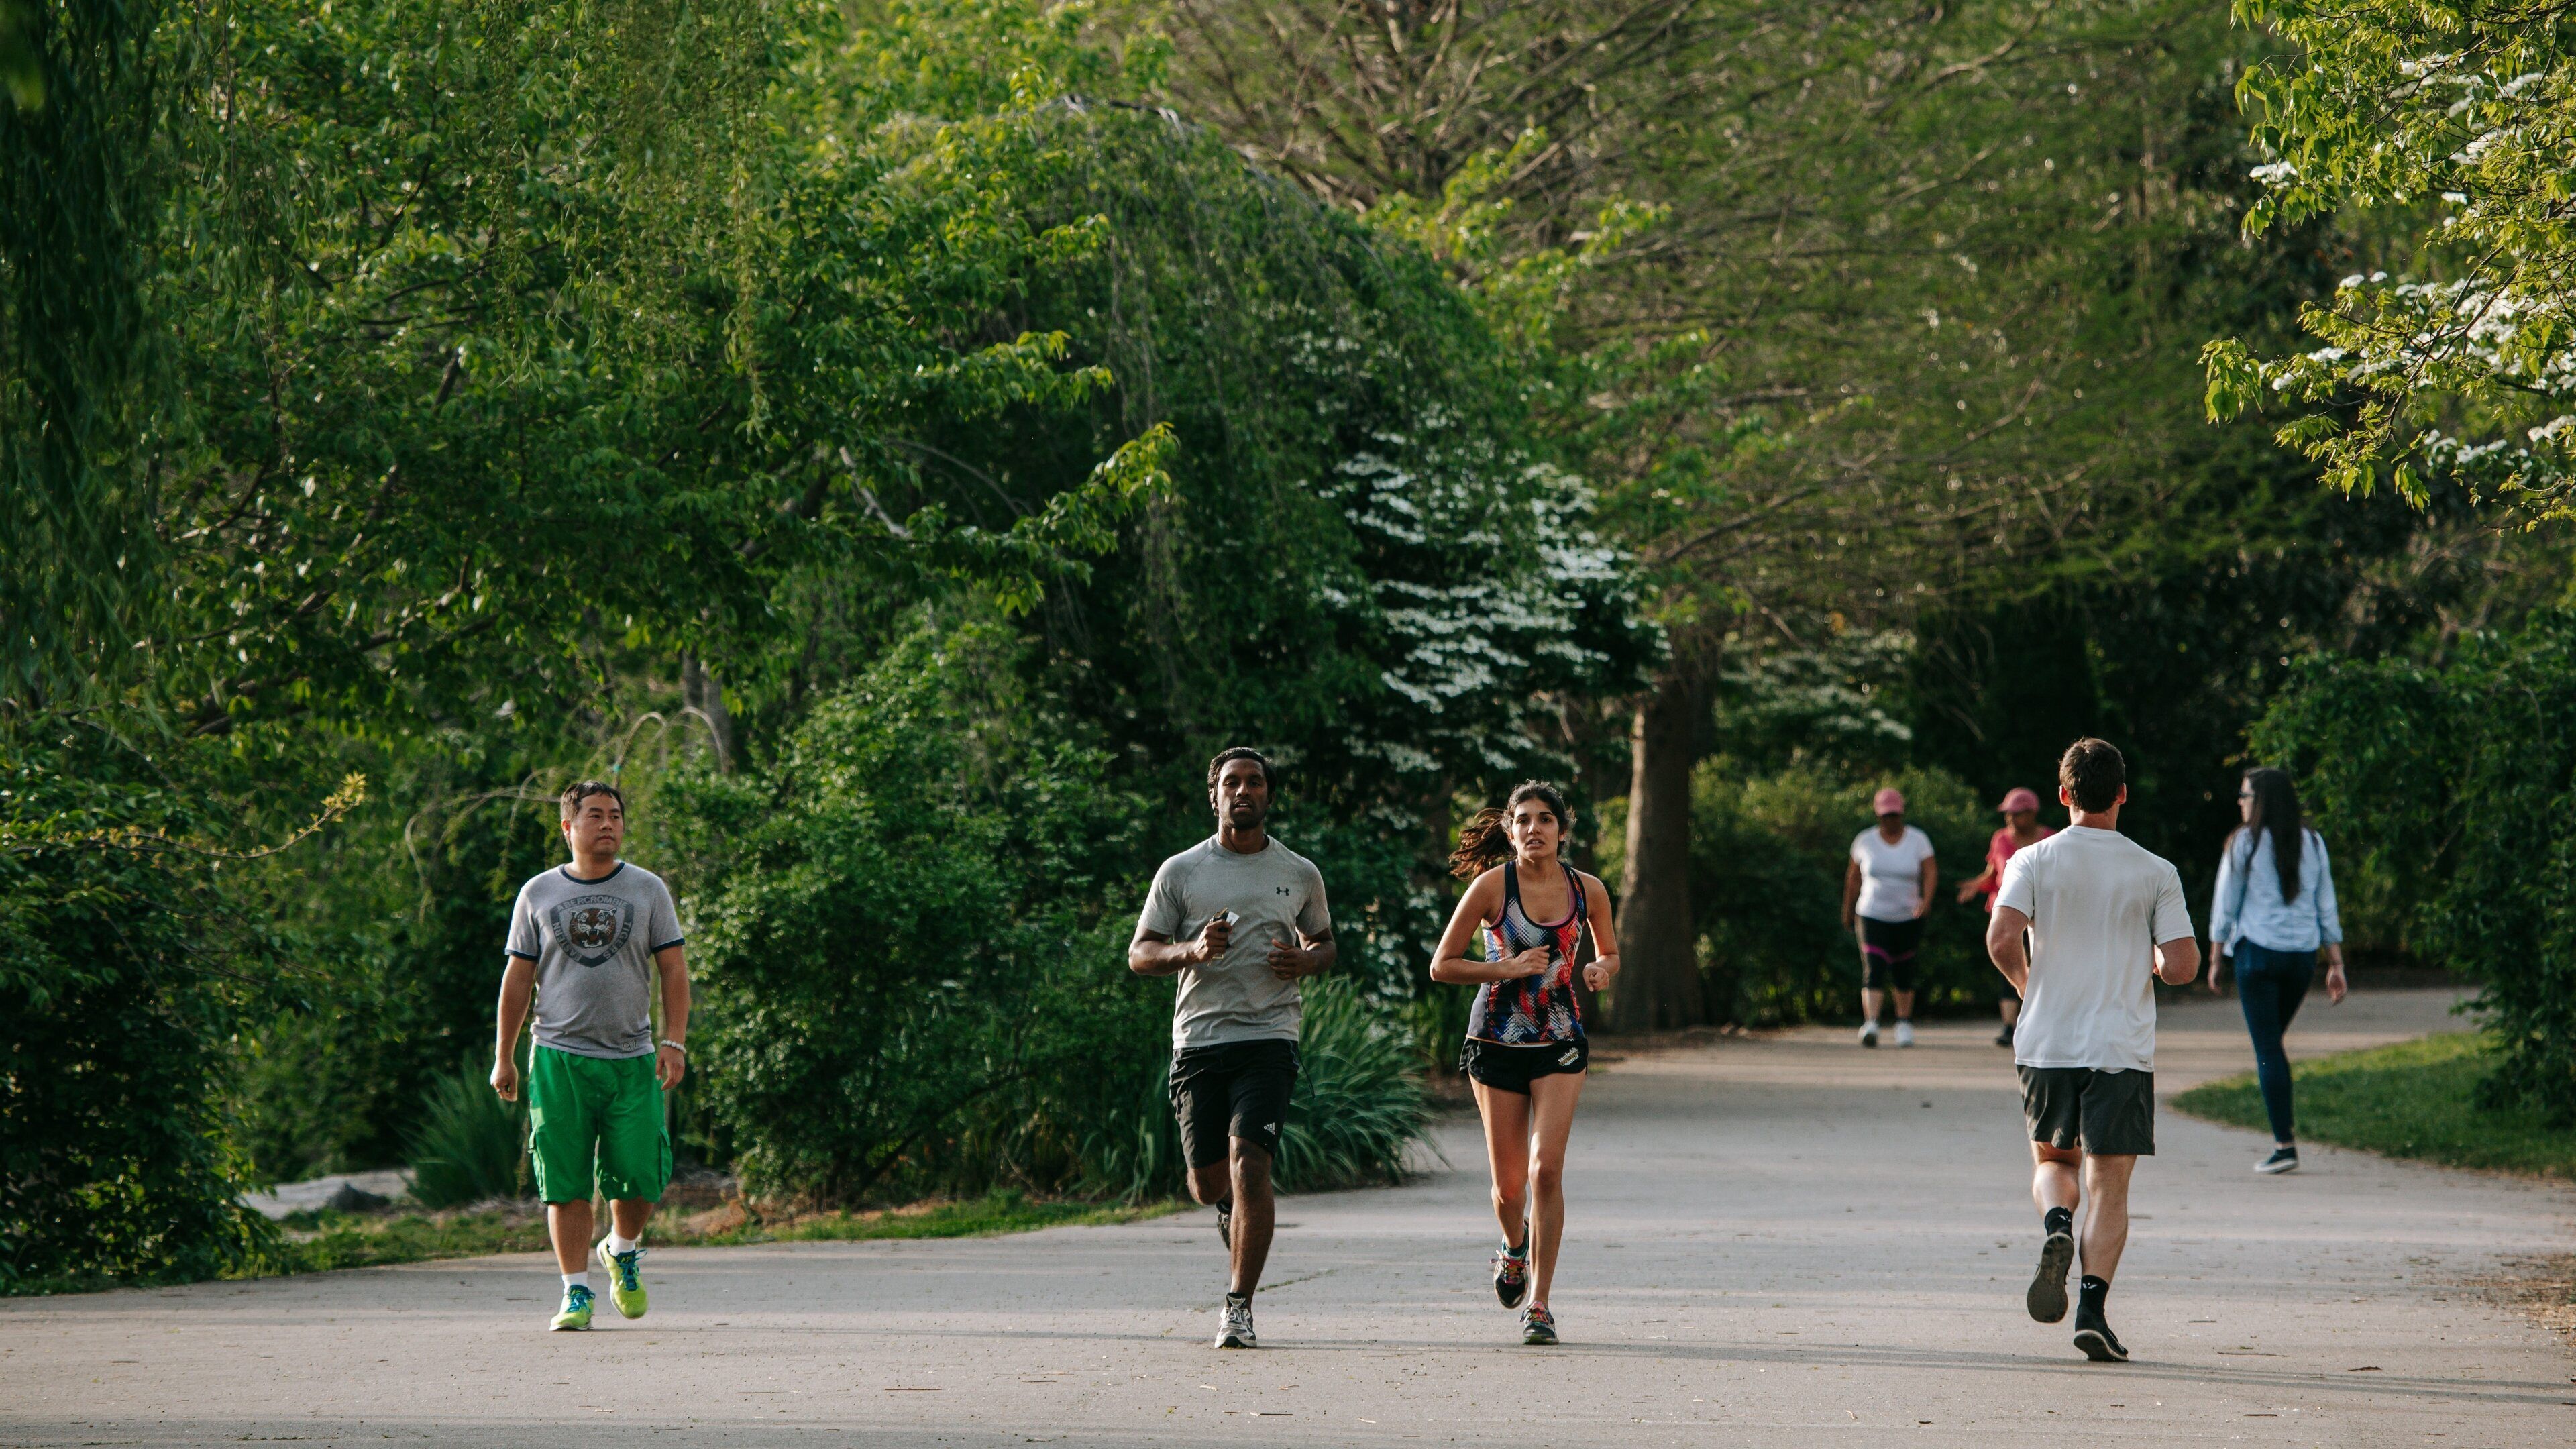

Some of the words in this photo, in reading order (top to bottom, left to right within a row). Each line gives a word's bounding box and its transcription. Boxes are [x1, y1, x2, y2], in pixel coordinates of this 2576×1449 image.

[558, 896, 628, 912] ABERCROMBIE
[553, 922, 582, 961] EASTERN
[604, 922, 631, 959] TIGERS
